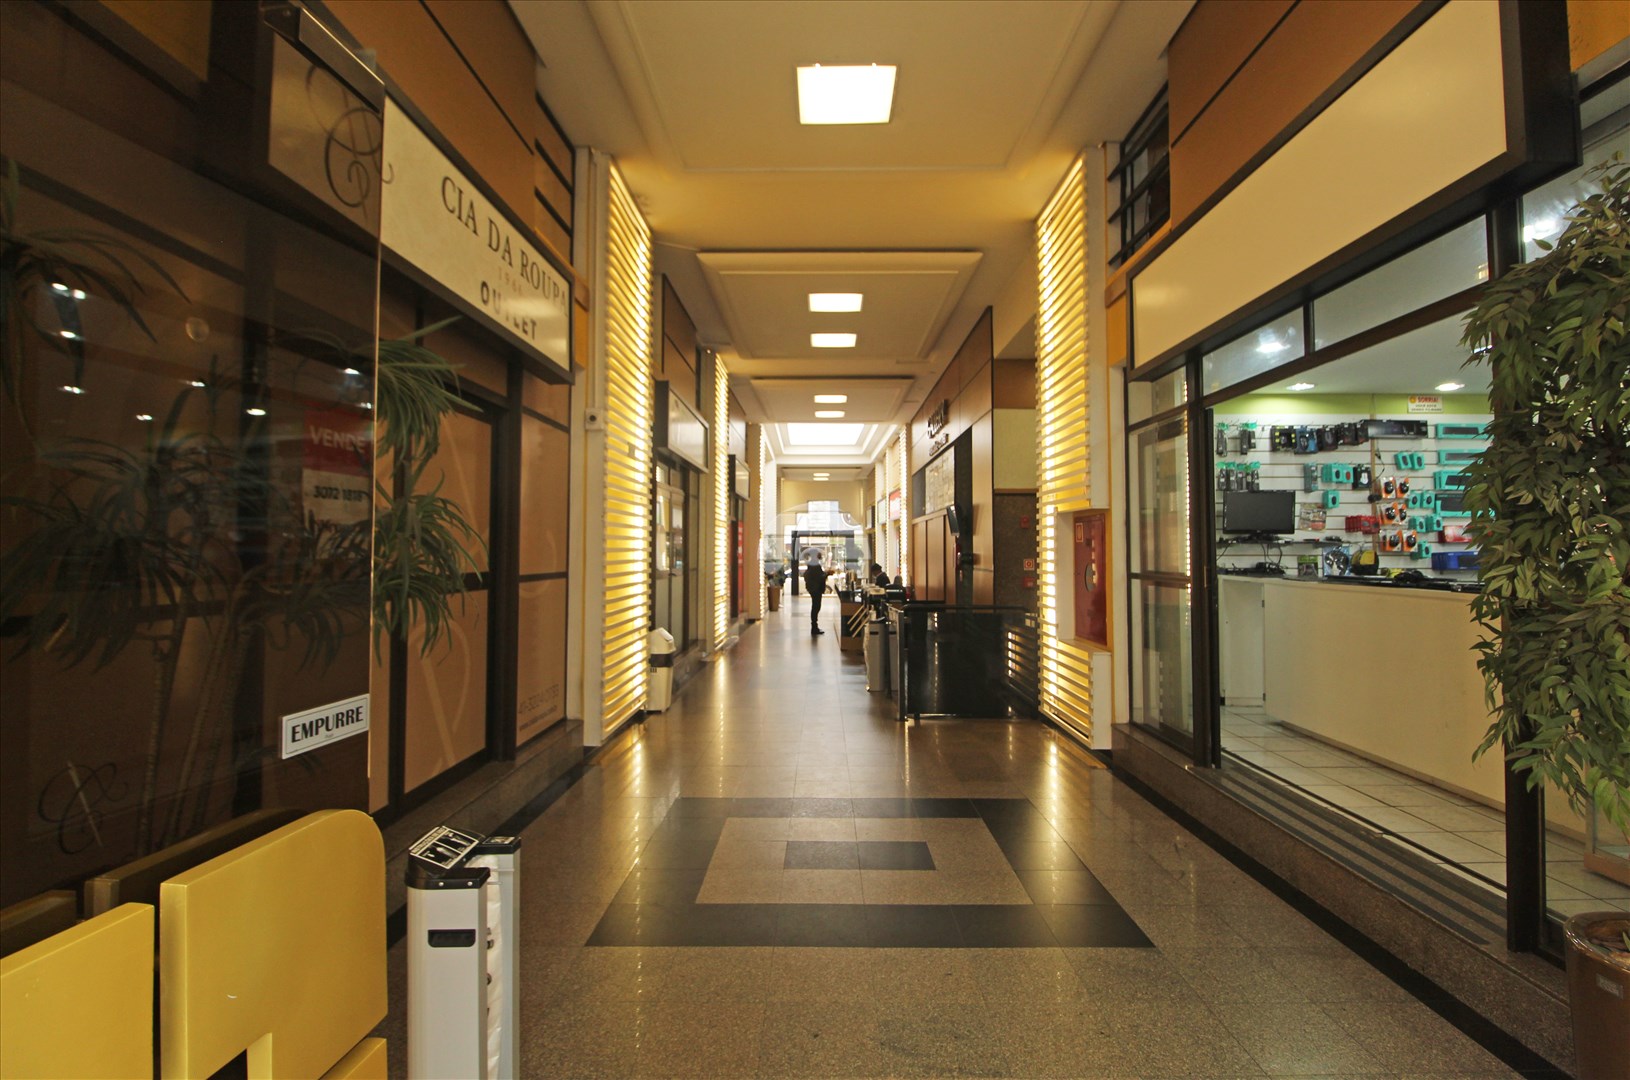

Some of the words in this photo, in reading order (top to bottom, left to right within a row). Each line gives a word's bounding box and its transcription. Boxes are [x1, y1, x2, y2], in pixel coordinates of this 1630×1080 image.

[441, 175, 479, 237] CIA
[487, 216, 514, 268] DA
[519, 248, 569, 318] ROUPA
[291, 705, 364, 743] EMPURRE
